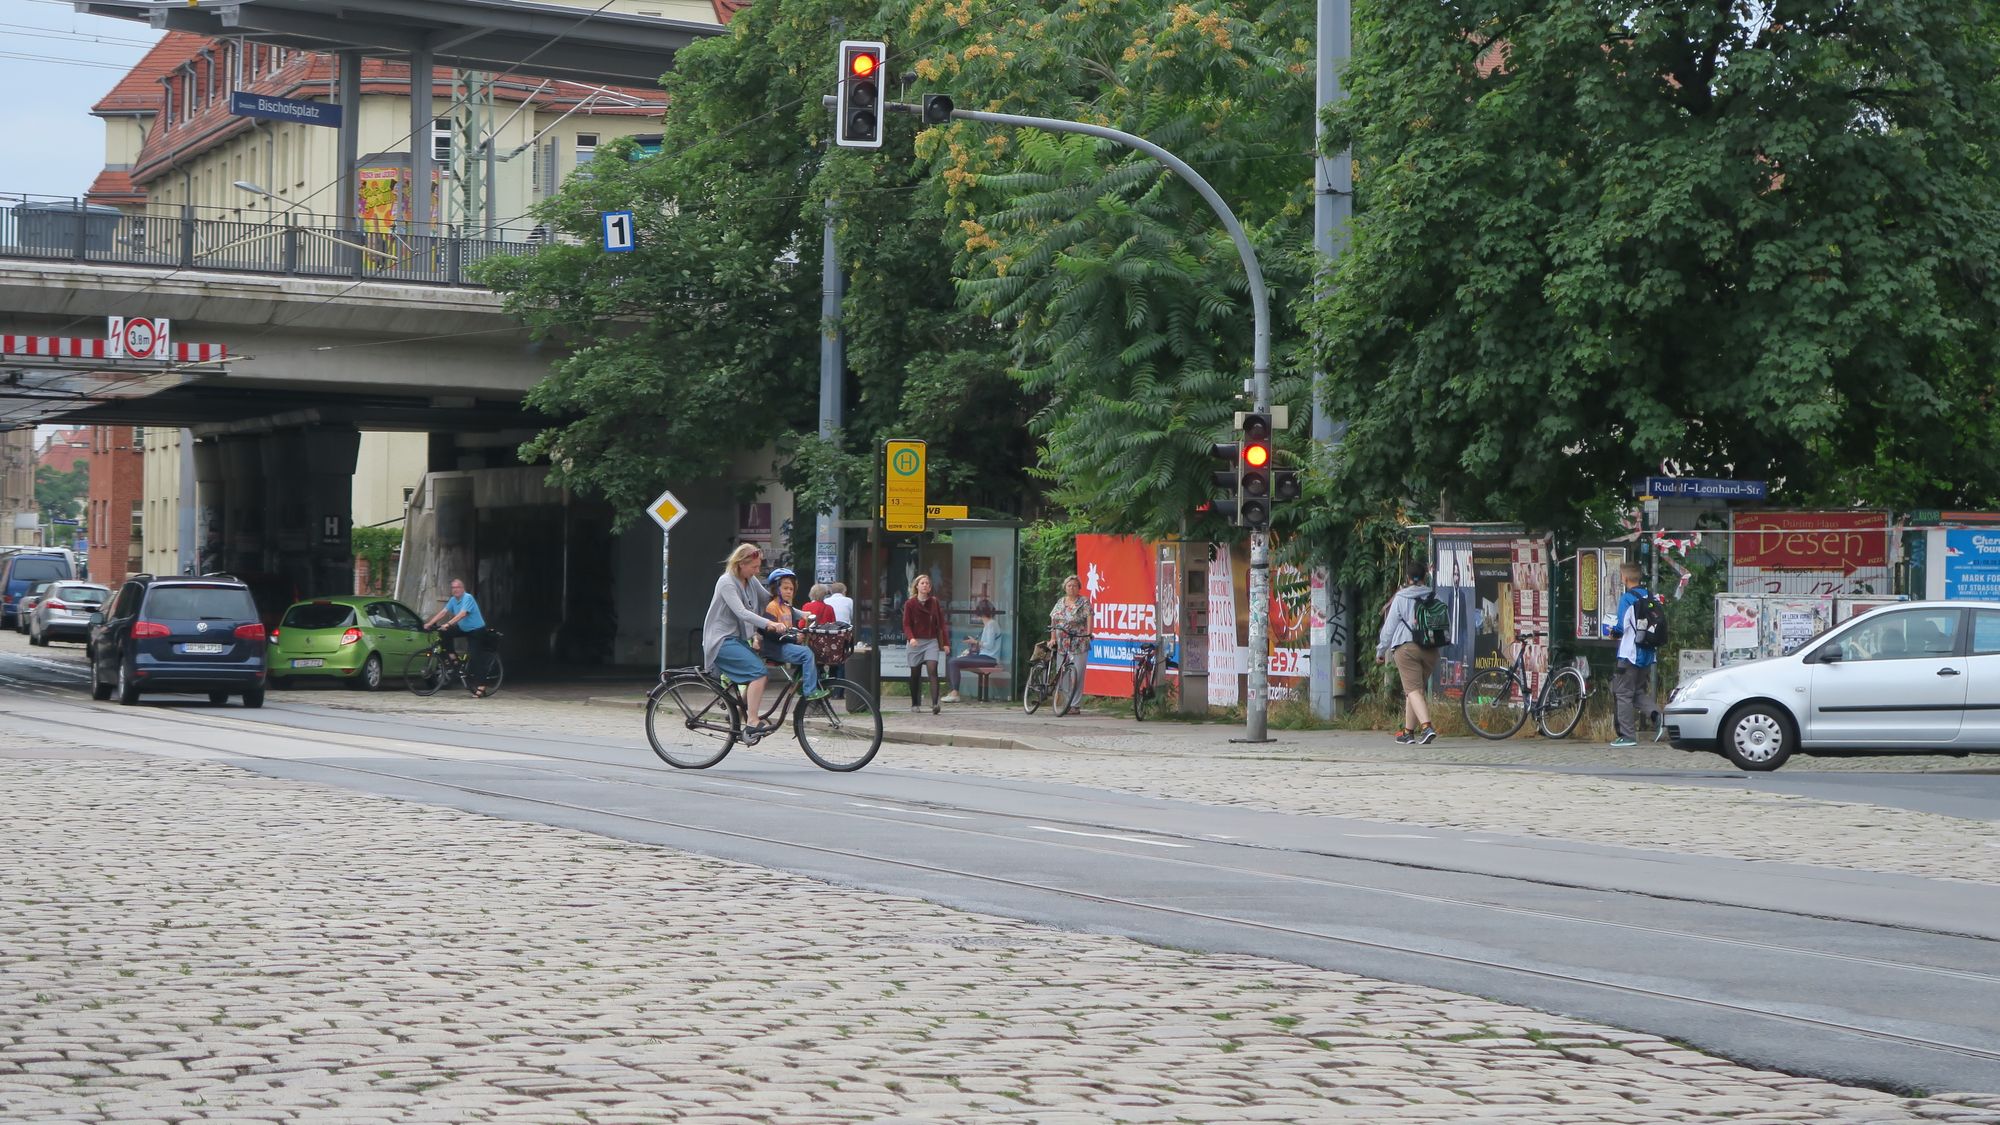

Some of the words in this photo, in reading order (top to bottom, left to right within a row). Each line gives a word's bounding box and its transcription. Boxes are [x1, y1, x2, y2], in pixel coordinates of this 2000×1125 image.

[258, 99, 319, 118] Bischofsplatz
[612, 217, 625, 245] 1
[325, 516, 338, 536] H
[1759, 523, 1863, 556] Desen
[1961, 574, 1984, 582] MARK
[1271, 652, 1299, 673] 29.7.
